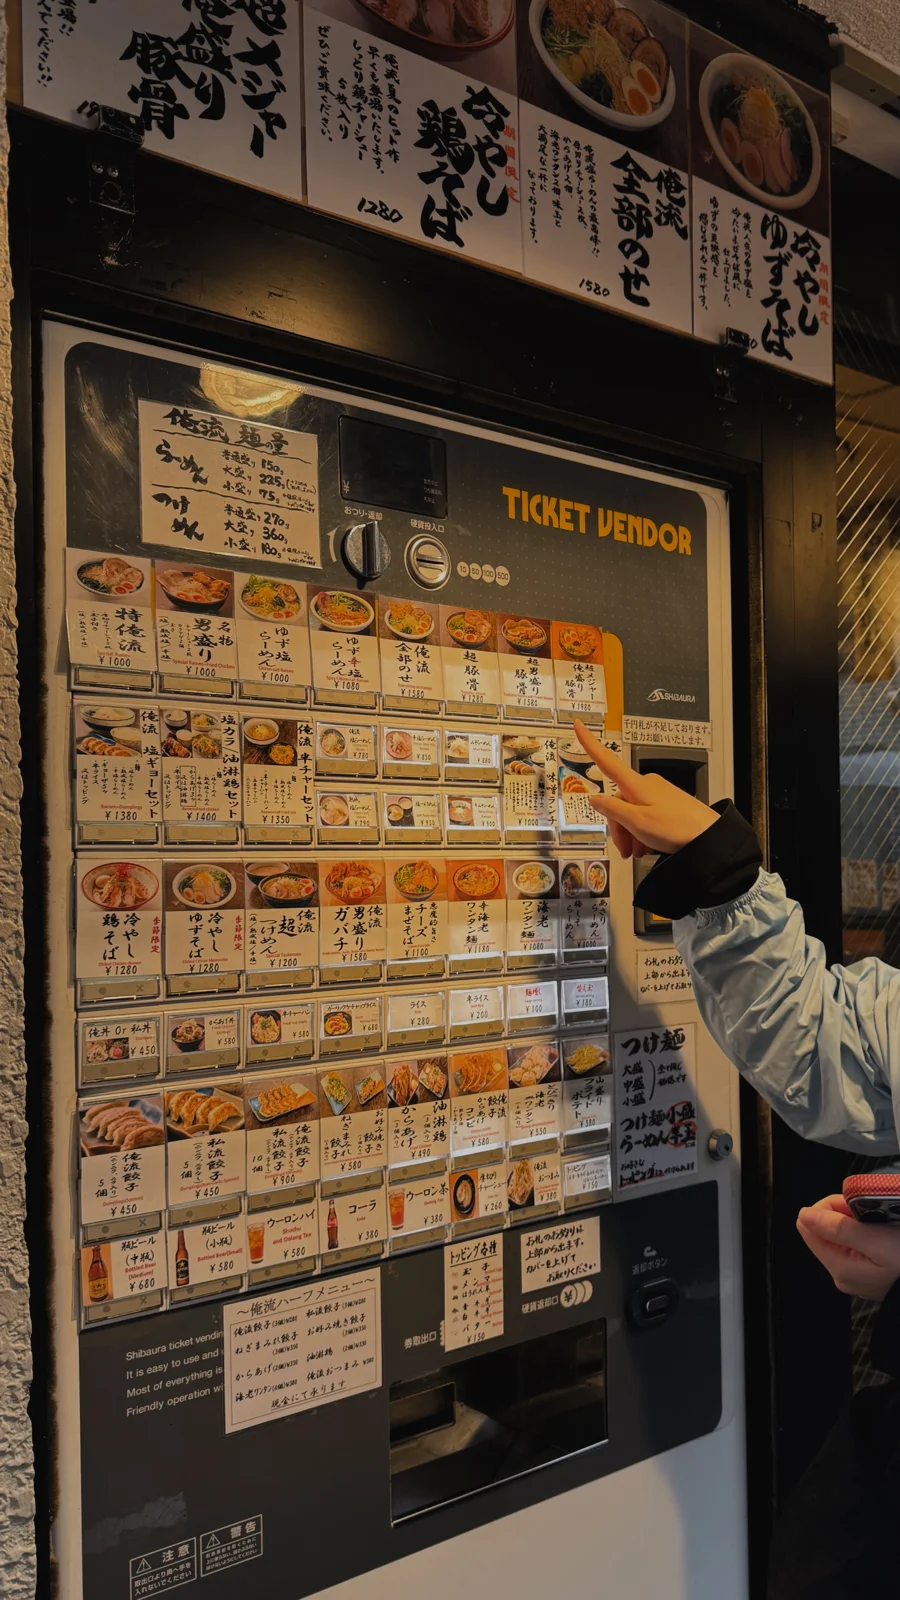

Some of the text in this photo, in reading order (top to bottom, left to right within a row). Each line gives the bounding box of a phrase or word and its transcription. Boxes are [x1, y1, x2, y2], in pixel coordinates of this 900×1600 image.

[119, 31, 190, 140] 豚骨
[461, 85, 511, 217] 冷やし
[413, 99, 475, 248] 鶏そば
[357, 197, 403, 224] 1280
[653, 167, 688, 240] 俺流
[610, 150, 653, 308] 全部のせ
[579, 278, 610, 297] 1580
[760, 213, 796, 361] ゆずそば
[790, 228, 822, 336] 冷やし
[162, 407, 230, 443] 俺流
[410, 518, 445, 534] 硬貨投入口
[502, 485, 591, 535] TICKET
[597, 507, 693, 556] VENDOR
[114, 607, 146, 653] 特俺流
[192, 618, 217, 663] 男盛り
[217, 621, 234, 647] 名物
[258, 631, 275, 668] らーめん
[275, 627, 293, 662] ゆず塩
[346, 637, 363, 678] ゆず辛塩
[331, 641, 347, 676] らーめん
[395, 642, 413, 683] 全部のせ
[413, 645, 431, 674] 俺流
[463, 650, 480, 691] 超豚骨
[514, 669, 528, 695] 豚骨
[526, 657, 542, 695] 超男盛り
[564, 680, 576, 699] 豚骨
[584, 664, 597, 700] 超メジャー
[624, 719, 710, 735] 千円札が不足しております。
[624, 731, 704, 746] ご協力お願いいたします。
[140, 710, 160, 819] 俺流 塩ギョーセット
[298, 753, 314, 823] 半チャーセット
[546, 773, 558, 825] 味噌ランチ
[278, 915, 298, 937] 超
[402, 905, 415, 946] まぜそば
[415, 903, 428, 938] チーズ
[466, 902, 478, 945] ワンタン麺
[478, 901, 490, 933] 辛海老
[520, 900, 535, 939] ワンタン麺
[536, 900, 551, 928] 海老
[599, 899, 608, 926] あさり
[102, 912, 120, 961] 鶏そば
[123, 911, 141, 959] 冷やし
[188, 912, 204, 959] ゆずそば
[207, 911, 224, 953] 冷やし
[259, 919, 277, 955] つけめん
[333, 907, 350, 952] ガバチ
[351, 906, 368, 951] 男盛り
[270, 957, 298, 967] ¥1200
[410, 1000, 427, 1009] ライス
[88, 1022, 152, 1038] 俺丼 私丼
[410, 1017, 430, 1026] ¥280
[130, 1045, 156, 1056] ¥450
[621, 1027, 686, 1056] つけ麺
[622, 1061, 645, 1077] 大盛
[584, 1078, 595, 1109] フライド
[595, 1076, 605, 1106] 山盛り
[623, 1076, 645, 1094] 中盛
[487, 1095, 498, 1118] 餃子
[535, 1091, 547, 1108] 海老
[571, 1090, 582, 1119] ポテト
[622, 1091, 646, 1107] 小盛
[374, 1109, 385, 1151] お好み焼き
[400, 1106, 417, 1147] からあげ
[432, 1100, 447, 1142] 油淋鶏
[465, 1107, 475, 1128] コンビ
[271, 1128, 287, 1171] 私流餃子
[294, 1124, 312, 1168] 俺流餃子
[330, 1138, 341, 1160] 餃子
[340, 1115, 352, 1157] ねぎまみれ
[363, 1131, 375, 1154] 餃子
[122, 1151, 142, 1192] 俺流餃子
[180, 1160, 193, 1179] 5個
[206, 1138, 226, 1182] 私流餃子
[95, 1178, 108, 1198] 5個
[406, 1182, 449, 1202] ウーロン茶
[110, 1203, 137, 1217] ¥450
[266, 1209, 316, 1228] ウーロンハイ
[348, 1199, 377, 1215] コーラ
[424, 1213, 443, 1225] ¥380
[484, 1201, 503, 1212] ¥260
[201, 1221, 235, 1236] 瓶ビール
[205, 1234, 233, 1250] (小瓶)
[358, 1229, 379, 1241] ¥380
[121, 1236, 156, 1252] 瓶ビール
[125, 1249, 155, 1266] (中瓶)
[450, 1239, 497, 1264] トッピング各種
[525, 1238, 584, 1260] 上部から出ます。
[526, 1253, 576, 1274] カバーを上げて
[631, 1257, 668, 1276] 返却ボタン
[129, 1278, 155, 1291] ¥680
[306, 1301, 341, 1318] 私流餃子
[521, 1295, 559, 1314] 硬貨返却口
[234, 1320, 271, 1337] 俺流餃子
[307, 1313, 366, 1336] お好み焼き餃子
[126, 1337, 194, 1361] Shibaura ticket
[404, 1331, 437, 1349] 券取出口
[126, 1348, 219, 1380] It is easy to use and
[235, 1364, 272, 1381] からあげ
[307, 1359, 359, 1381] 俺流おつまみ
[126, 1365, 223, 1399] Most of everything is
[126, 1387, 211, 1417] Friendly operation
[230, 1521, 257, 1539] 警告
[162, 1543, 190, 1563] 注意
[134, 1562, 191, 1587] 取出口より奥へ手を
[134, 1571, 192, 1596] 入れないでください
